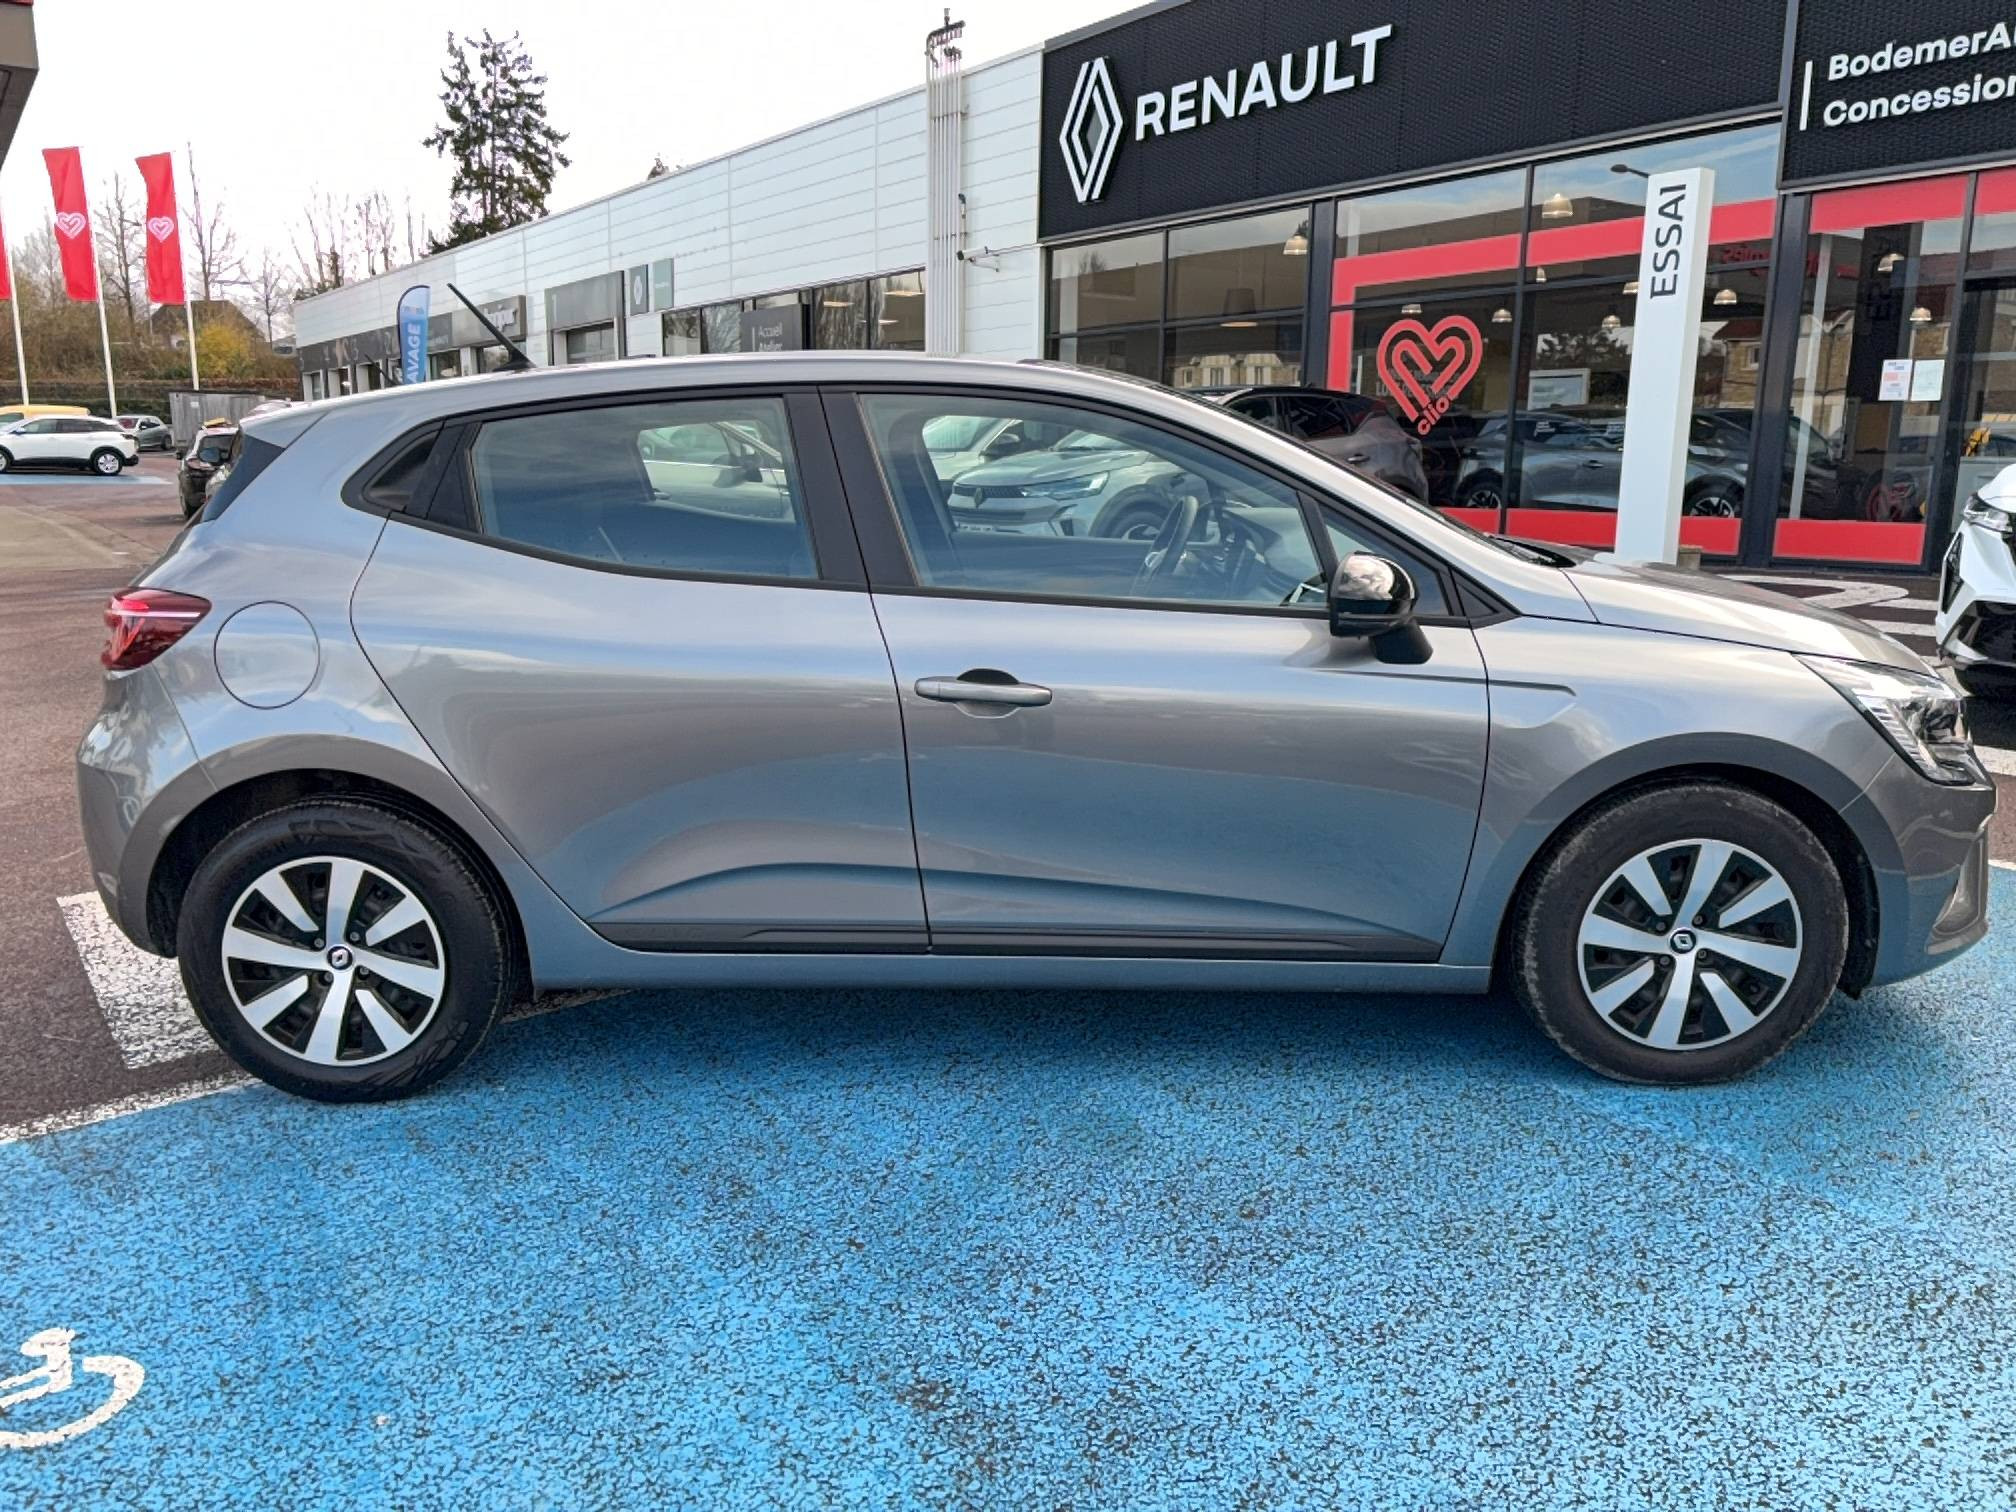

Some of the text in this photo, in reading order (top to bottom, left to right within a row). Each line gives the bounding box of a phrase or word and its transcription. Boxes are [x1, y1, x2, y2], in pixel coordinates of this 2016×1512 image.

[1135, 24, 1392, 142] RENAULT
[1828, 22, 2016, 81] BodemerA
[1650, 184, 1686, 299] ESSAI
[407, 322, 420, 385] AVAGE
[1417, 397, 1450, 436] clio
